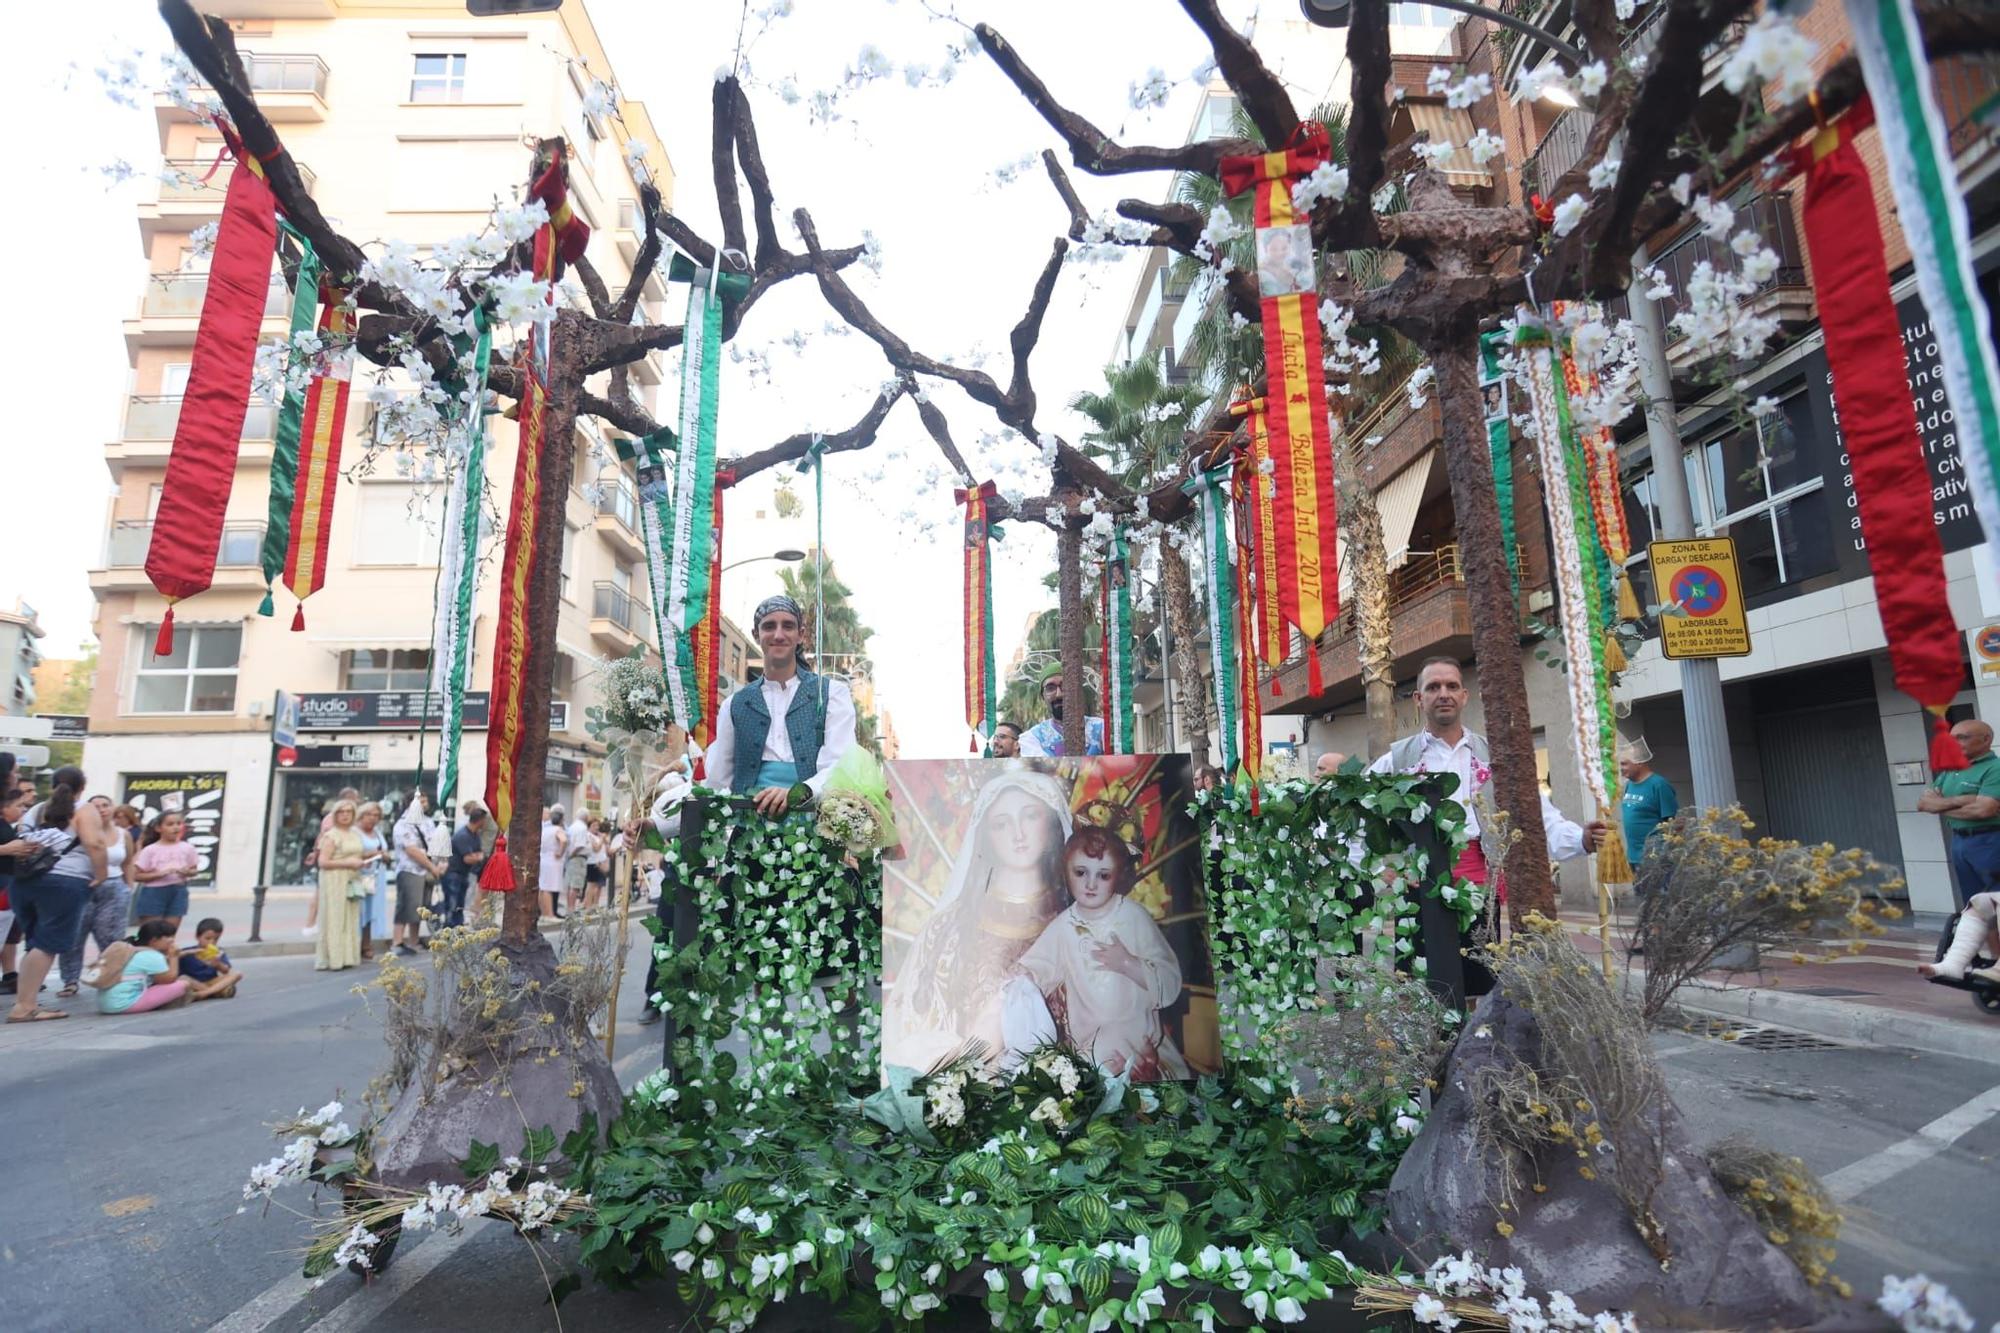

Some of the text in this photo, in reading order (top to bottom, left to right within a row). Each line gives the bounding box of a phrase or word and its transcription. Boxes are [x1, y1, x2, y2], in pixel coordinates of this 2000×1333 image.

[687, 414, 705, 463] Adriana
[1291, 434, 1313, 497] Belleza
[517, 493, 536, 567] Belleza
[682, 492, 702, 543] Damas
[1296, 506, 1316, 542] Inf.
[1655, 554, 1683, 565] CARGA
[1689, 552, 1731, 563] DESCARGA
[1671, 542, 1711, 554] ZONA DE
[679, 549, 698, 589] 2016
[1300, 553, 1320, 600] 2017
[1667, 630, 1676, 638] de
[1724, 626, 1744, 635] horas
[1679, 618, 1729, 628] LABORABLES
[1669, 639, 1678, 648] de
[1725, 636, 1745, 645] horas
[128, 780, 178, 791] AHORRA
[180, 780, 196, 790] EL
